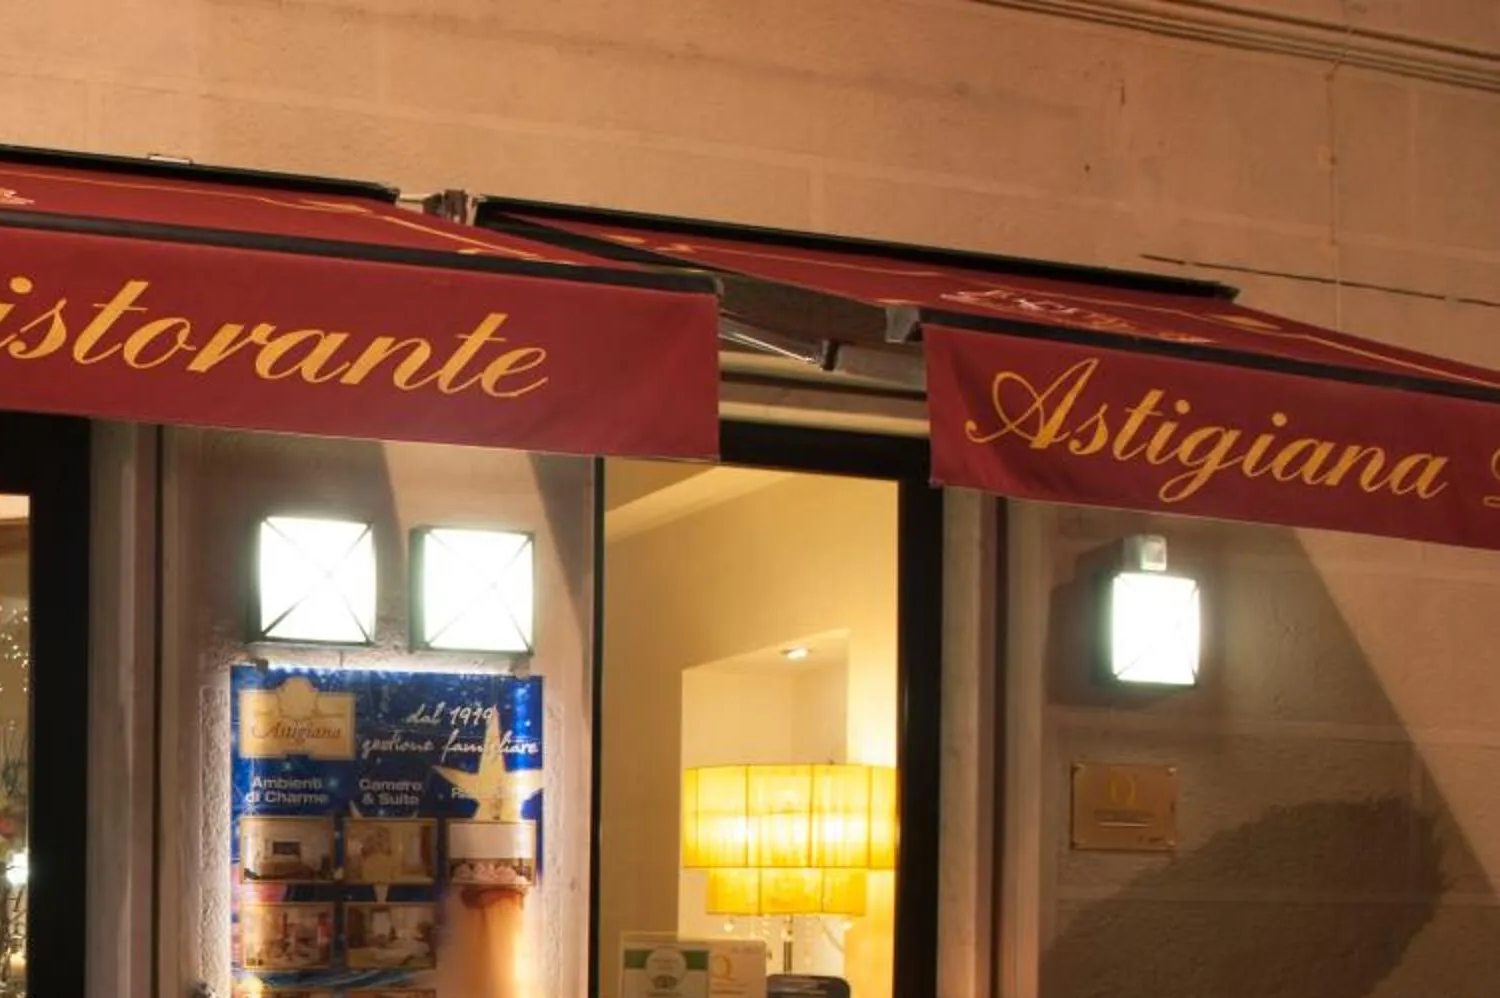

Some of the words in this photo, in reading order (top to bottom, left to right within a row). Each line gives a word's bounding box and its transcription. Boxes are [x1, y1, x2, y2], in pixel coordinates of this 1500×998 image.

[965, 357, 1448, 503] Astigiana
[251, 776, 323, 790] Ambienti
[265, 790, 329, 804] Charme
